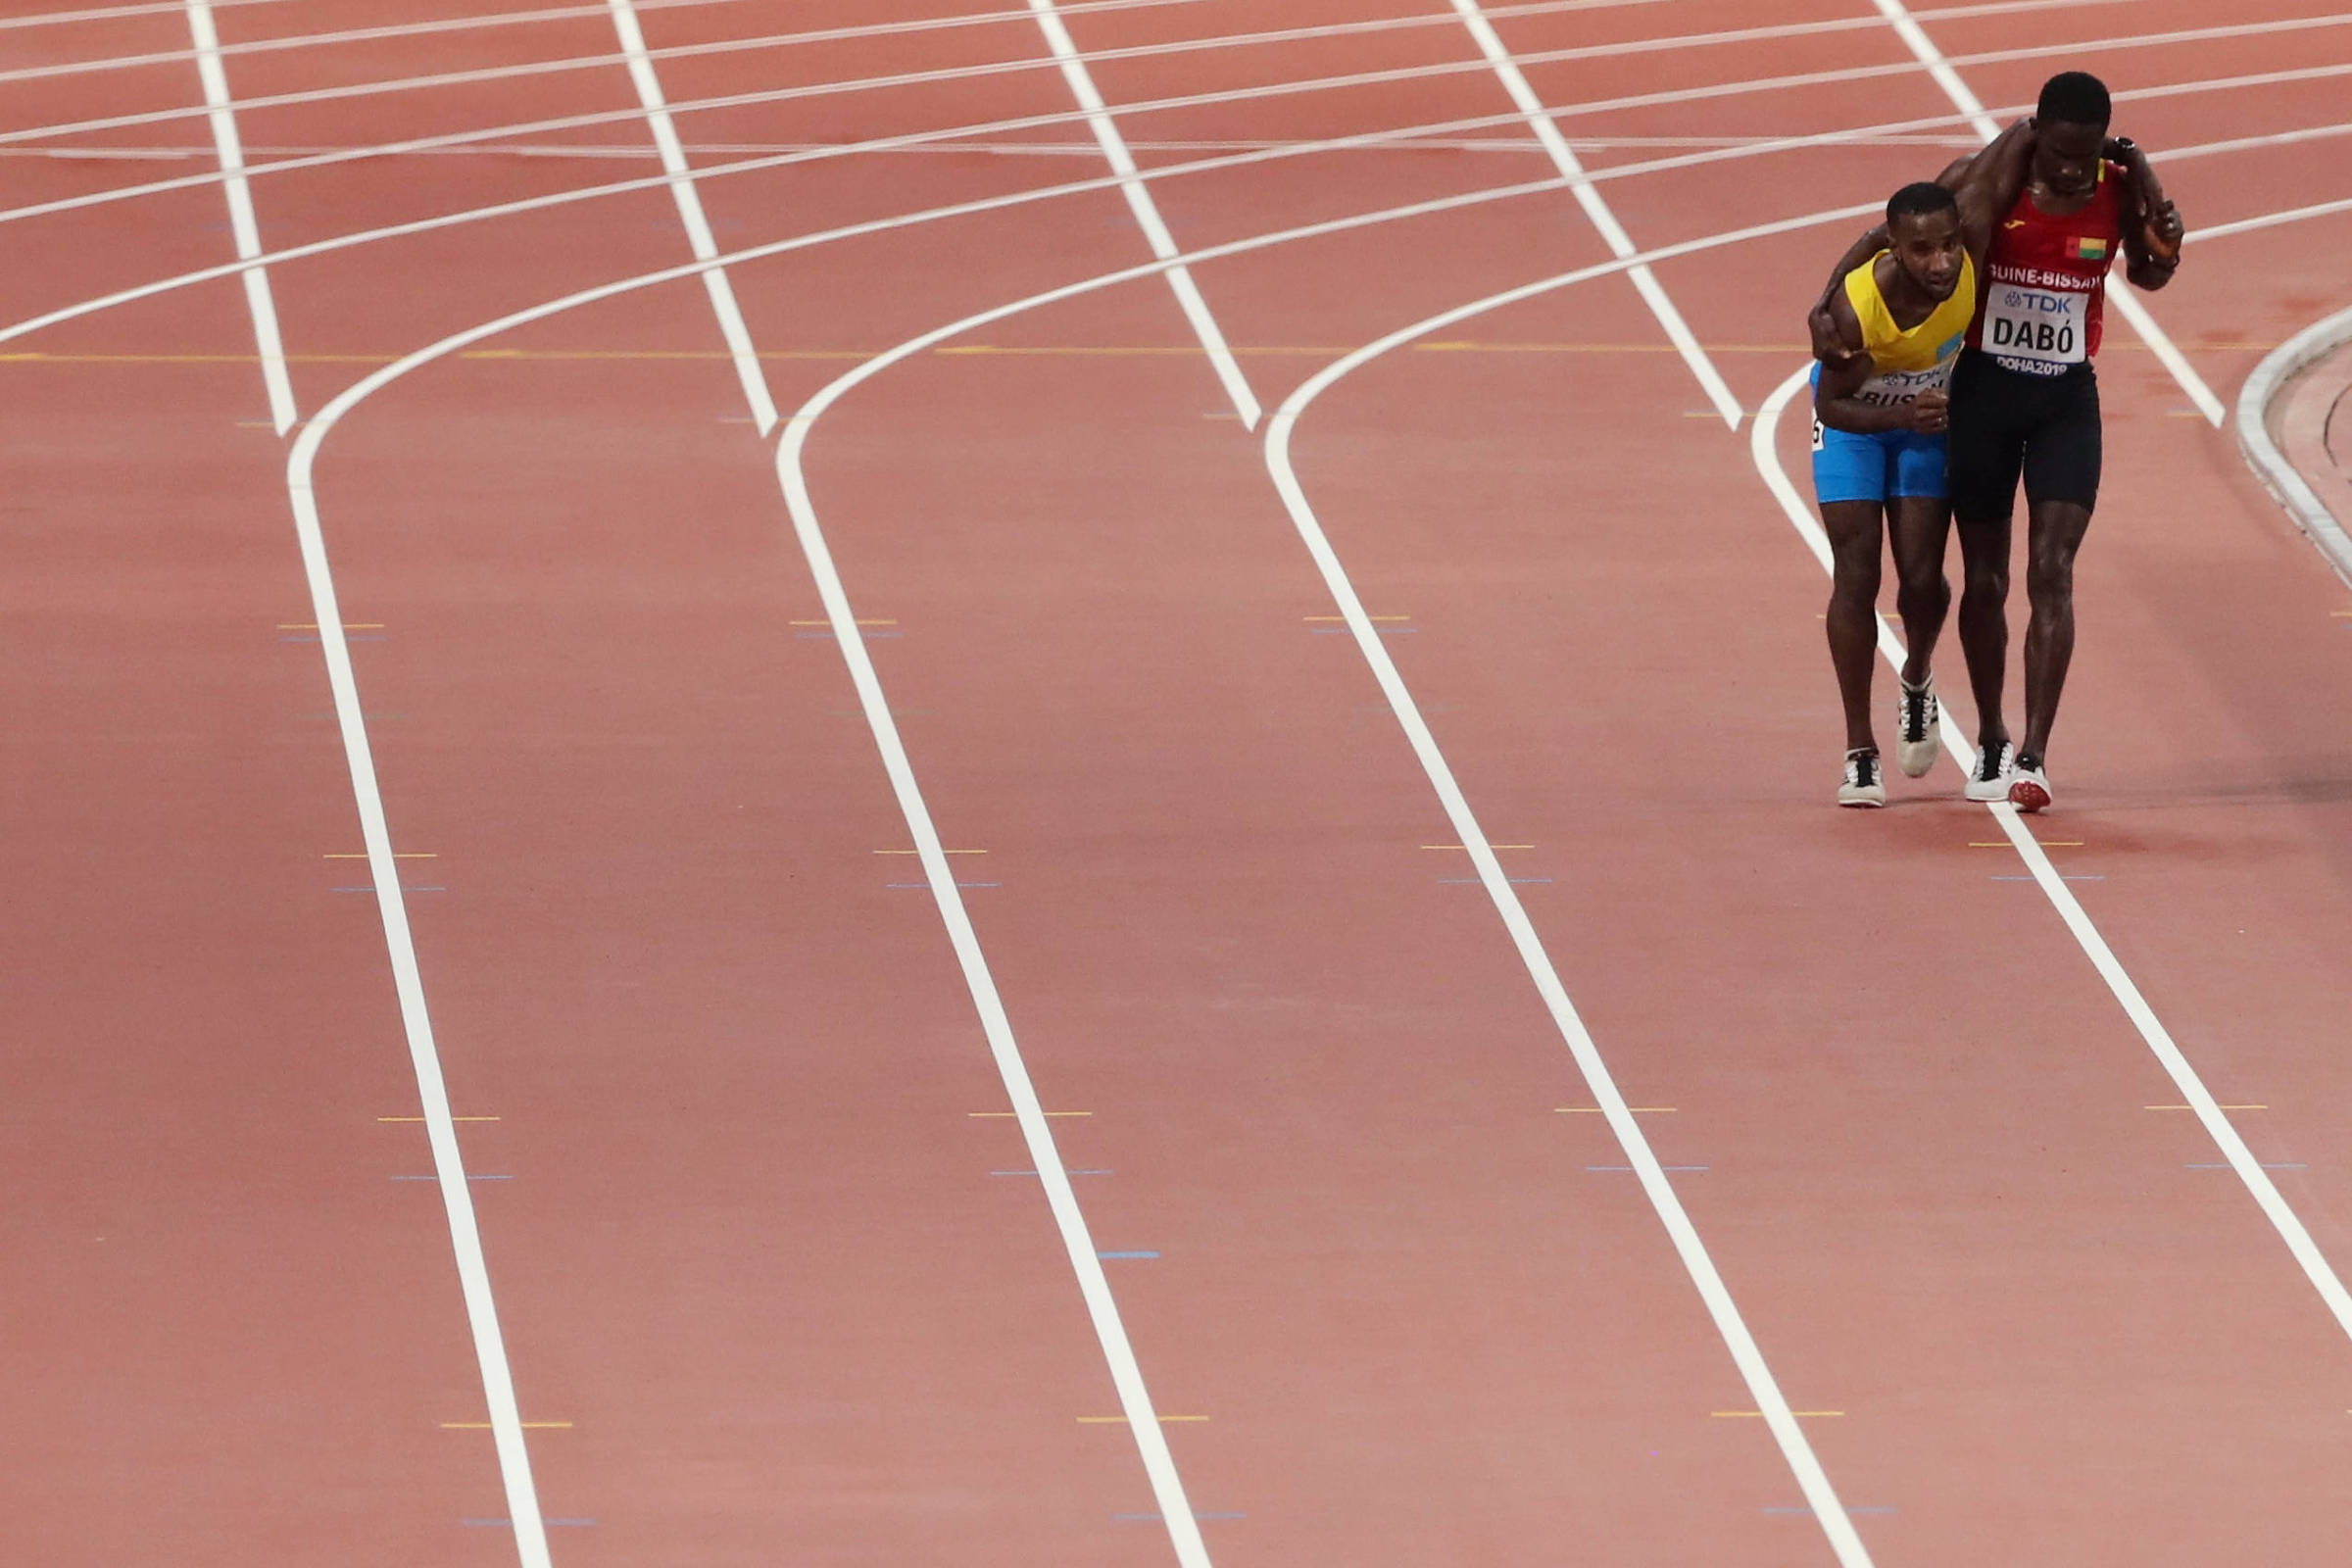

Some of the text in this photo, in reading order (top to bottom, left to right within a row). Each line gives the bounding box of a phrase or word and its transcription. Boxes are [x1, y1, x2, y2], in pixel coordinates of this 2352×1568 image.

[2022, 293, 2072, 315] TDK
[1992, 318, 2074, 354] DABÓ
[1996, 356, 2068, 376] DOHA2019
